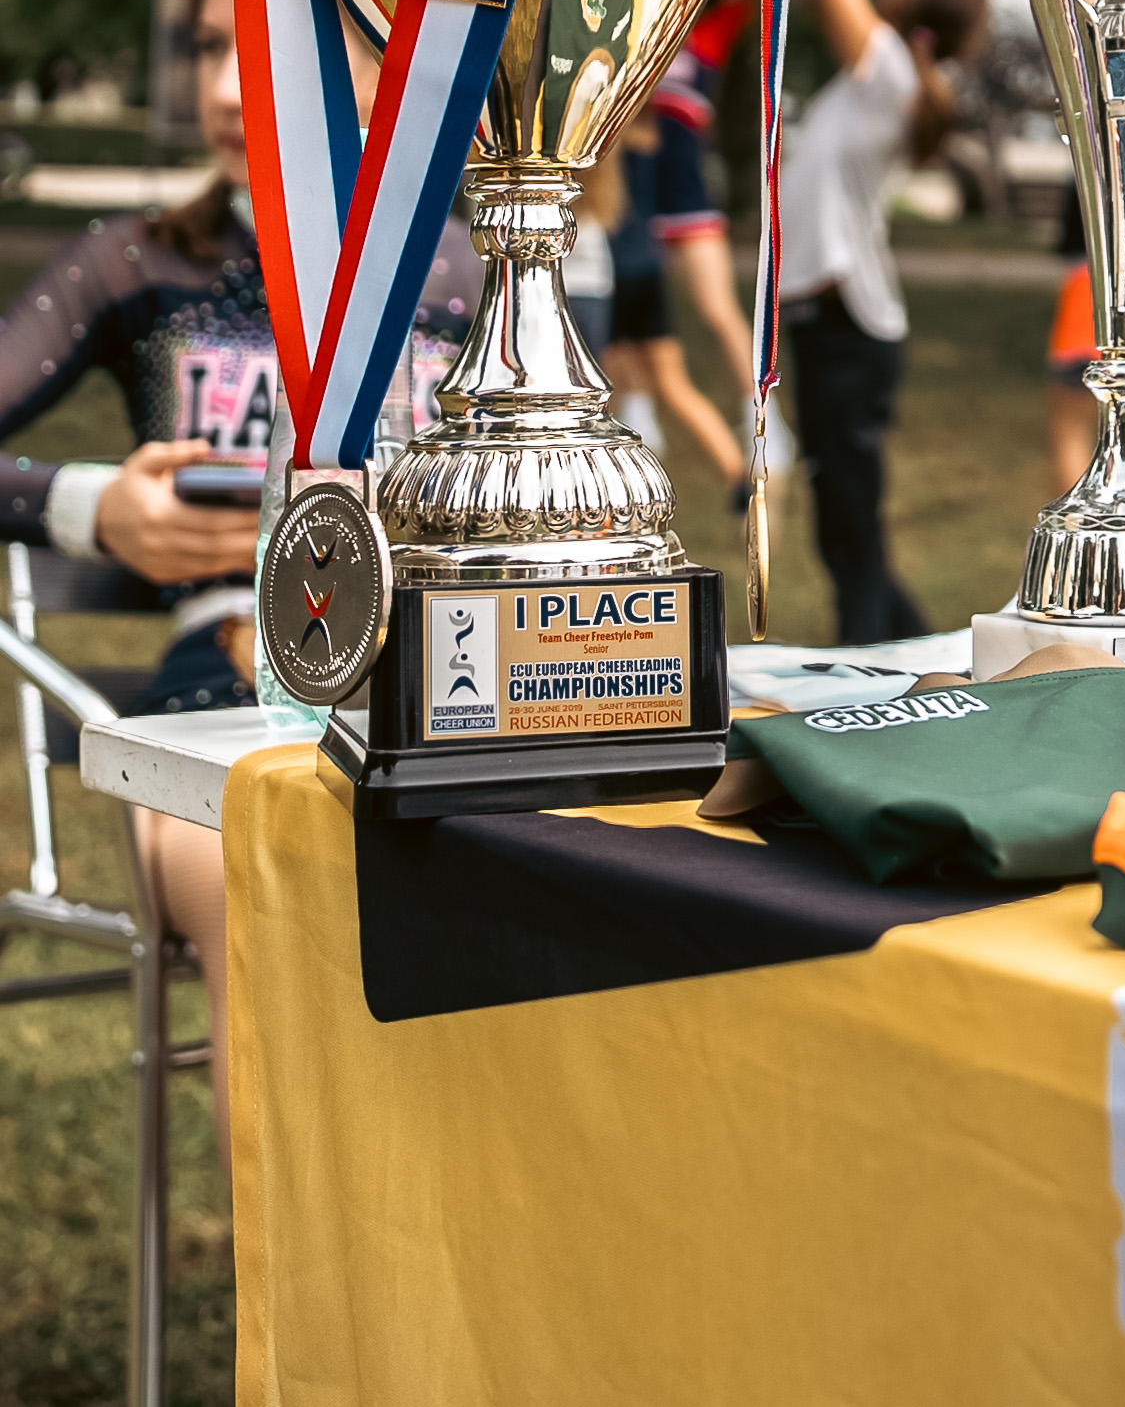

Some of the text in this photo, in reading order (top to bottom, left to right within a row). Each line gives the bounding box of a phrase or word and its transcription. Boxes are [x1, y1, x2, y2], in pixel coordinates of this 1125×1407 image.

[515, 590, 677, 630] I PLACE
[538, 630, 653, 643] Team Cheer Freestyle Pom
[584, 644, 609, 654] Senior
[510, 658, 681, 677] ECU EUROPEAN CHEERLEADING
[508, 673, 683, 701] CHAMPIONSHIPS
[434, 704, 494, 716] EUROPEAN
[509, 704, 582, 714] 28-30 JUNE 2019
[598, 699, 683, 710] SAINT PETERSBURG
[808, 690, 988, 731] CEDEVITA
[434, 718, 494, 729] CHEER UNION
[510, 709, 682, 730] RUSSIAN FEDERATION
